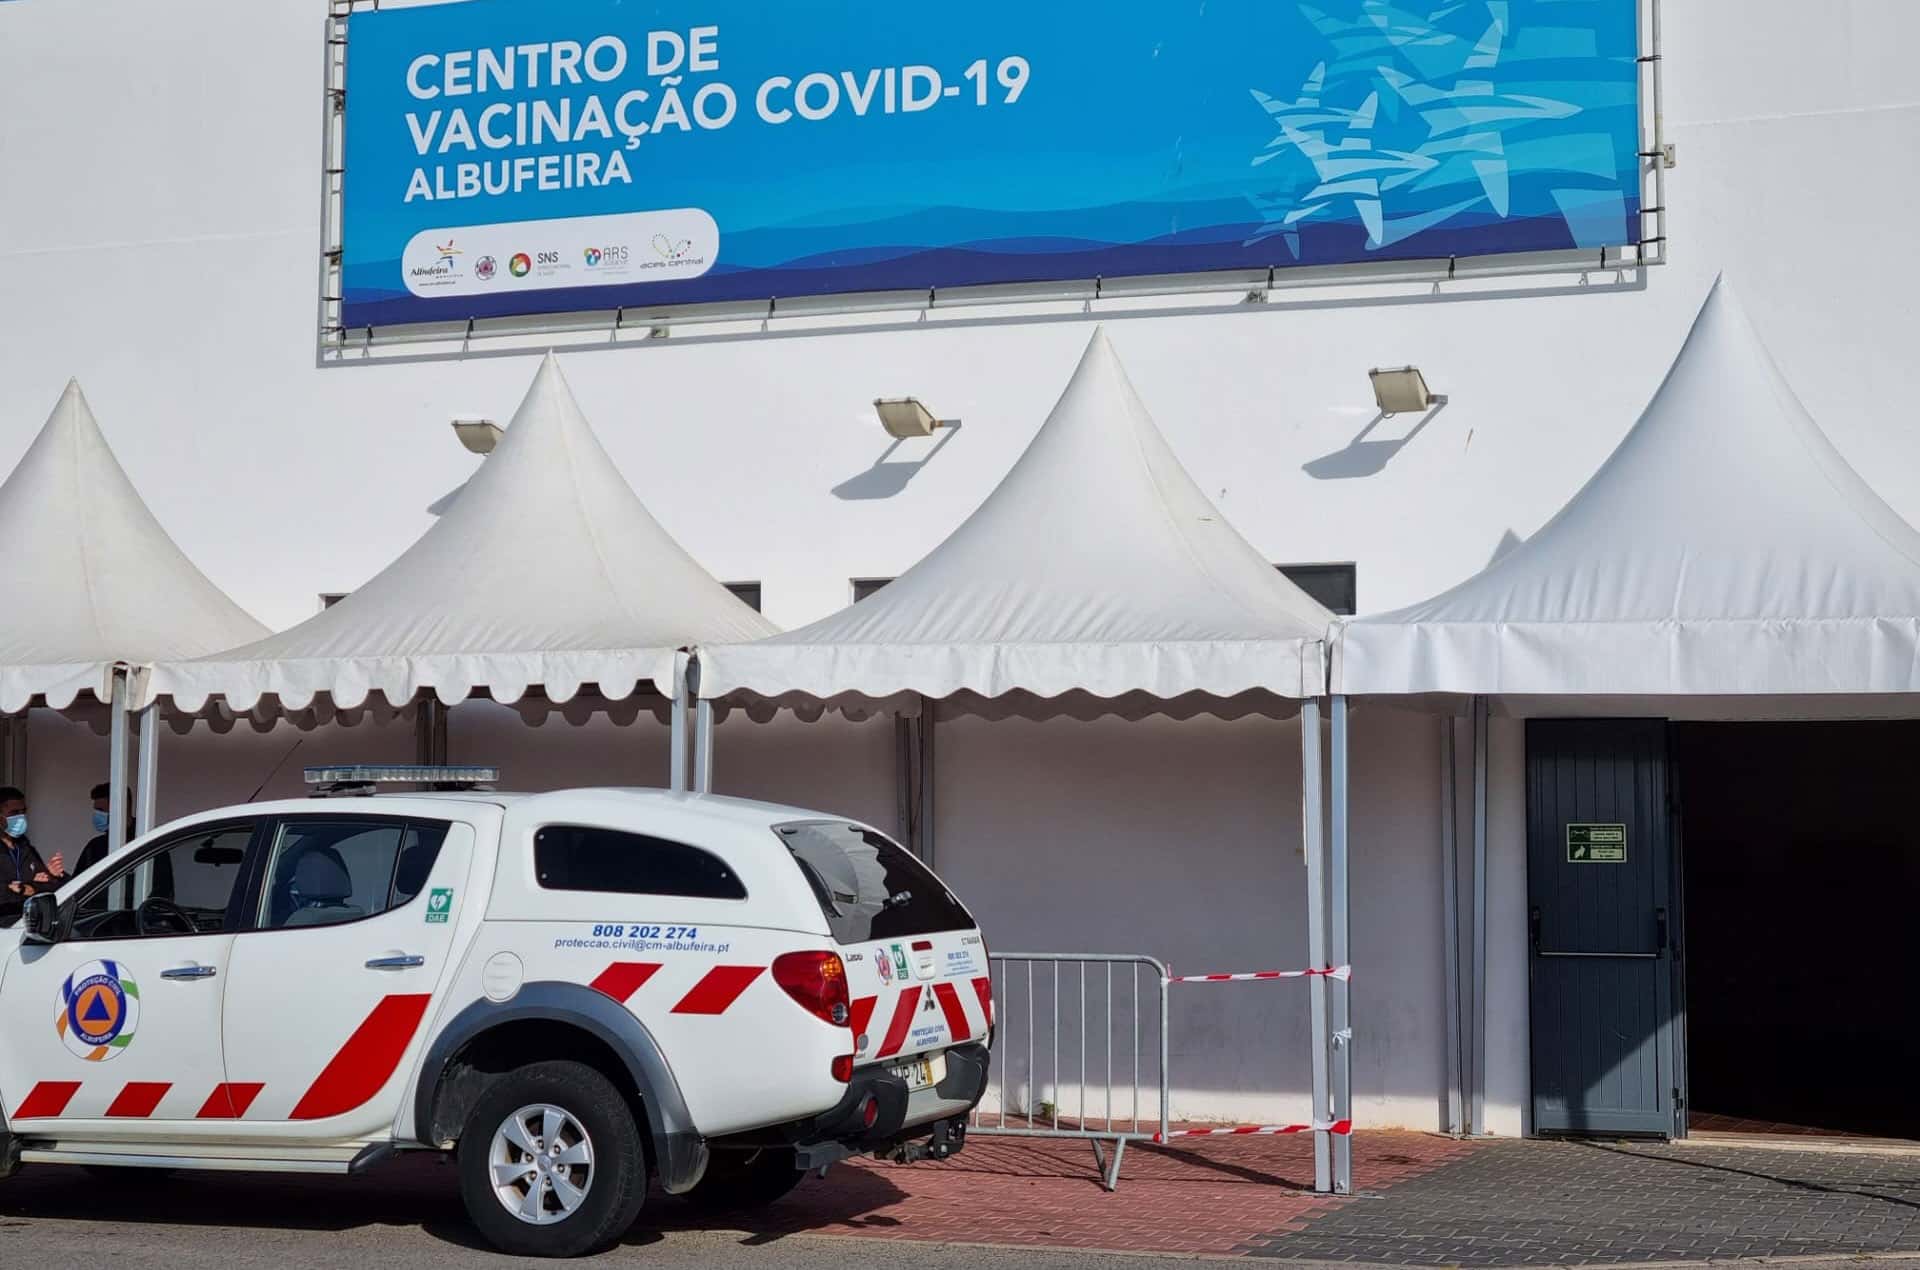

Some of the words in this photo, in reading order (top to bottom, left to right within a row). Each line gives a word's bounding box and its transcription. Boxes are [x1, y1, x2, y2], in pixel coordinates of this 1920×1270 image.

[406, 35, 627, 100] CENTRO
[647, 26, 719, 76] DE
[405, 76, 737, 155] VACINAÇÃO
[755, 56, 1030, 124] COVID-19
[404, 151, 632, 202] ALBUFEIRA
[537, 252, 559, 264] SNS
[603, 246, 629, 260] ARS
[668, 256, 704, 267] central
[593, 924, 624, 938] 808
[629, 925, 661, 939] 202
[666, 927, 697, 939] 274
[554, 938, 730, 954] proteccao.civil@cm-albufeira.pt
